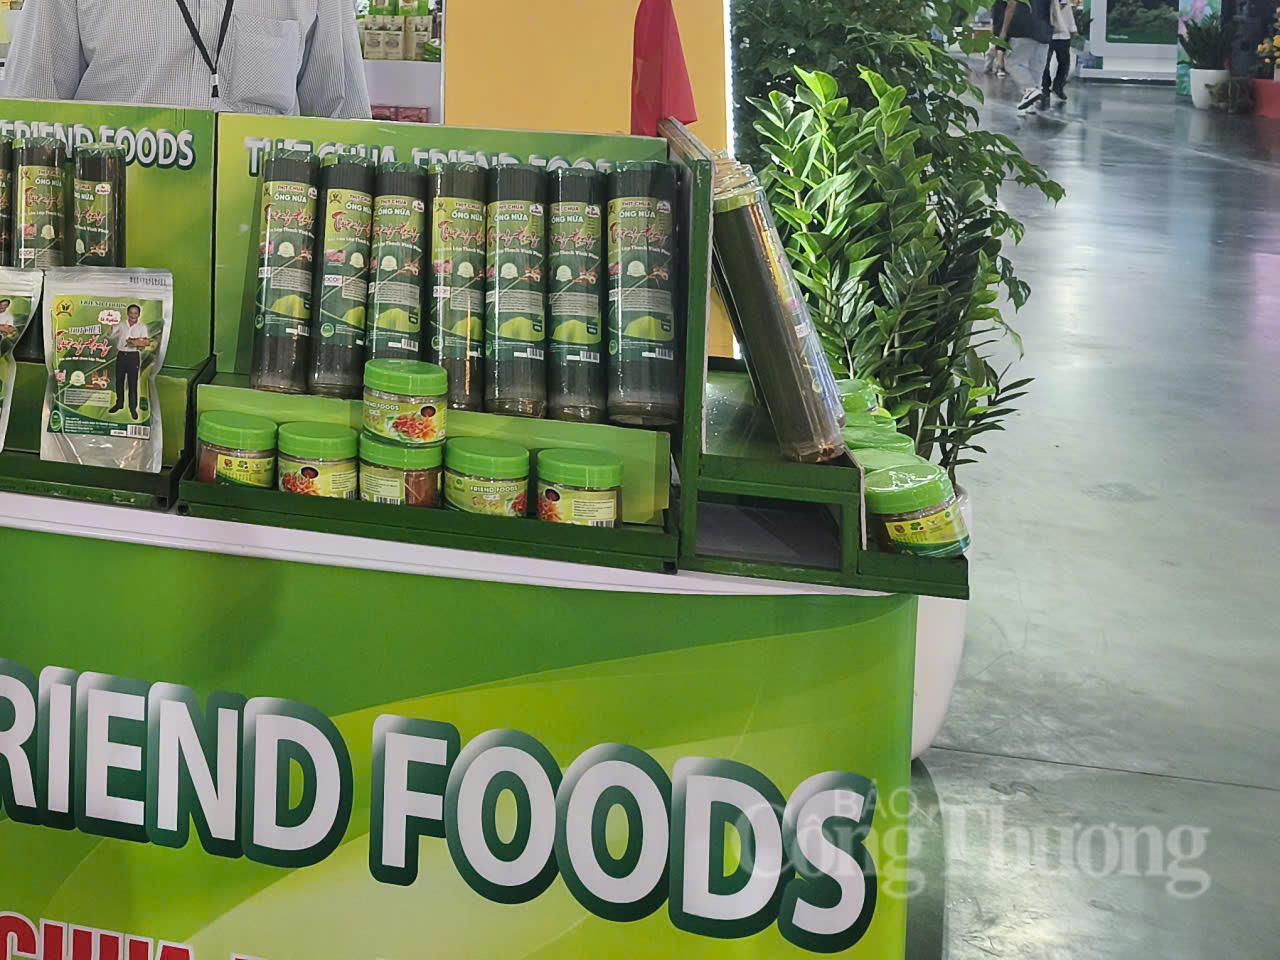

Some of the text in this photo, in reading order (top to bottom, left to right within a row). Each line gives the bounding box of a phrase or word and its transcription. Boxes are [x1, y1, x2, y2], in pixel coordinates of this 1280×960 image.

[273, 192, 307, 203] ỐNG NỨA
[377, 205, 411, 217] ỐNG NỨA
[451, 210, 470, 220] ỐNG
[619, 208, 656, 218] ỐNG NỨA
[511, 212, 528, 221] NỨA
[566, 214, 584, 223] NỨA
[495, 485, 518, 493] FOODS
[369, 713, 877, 953] FOODS
